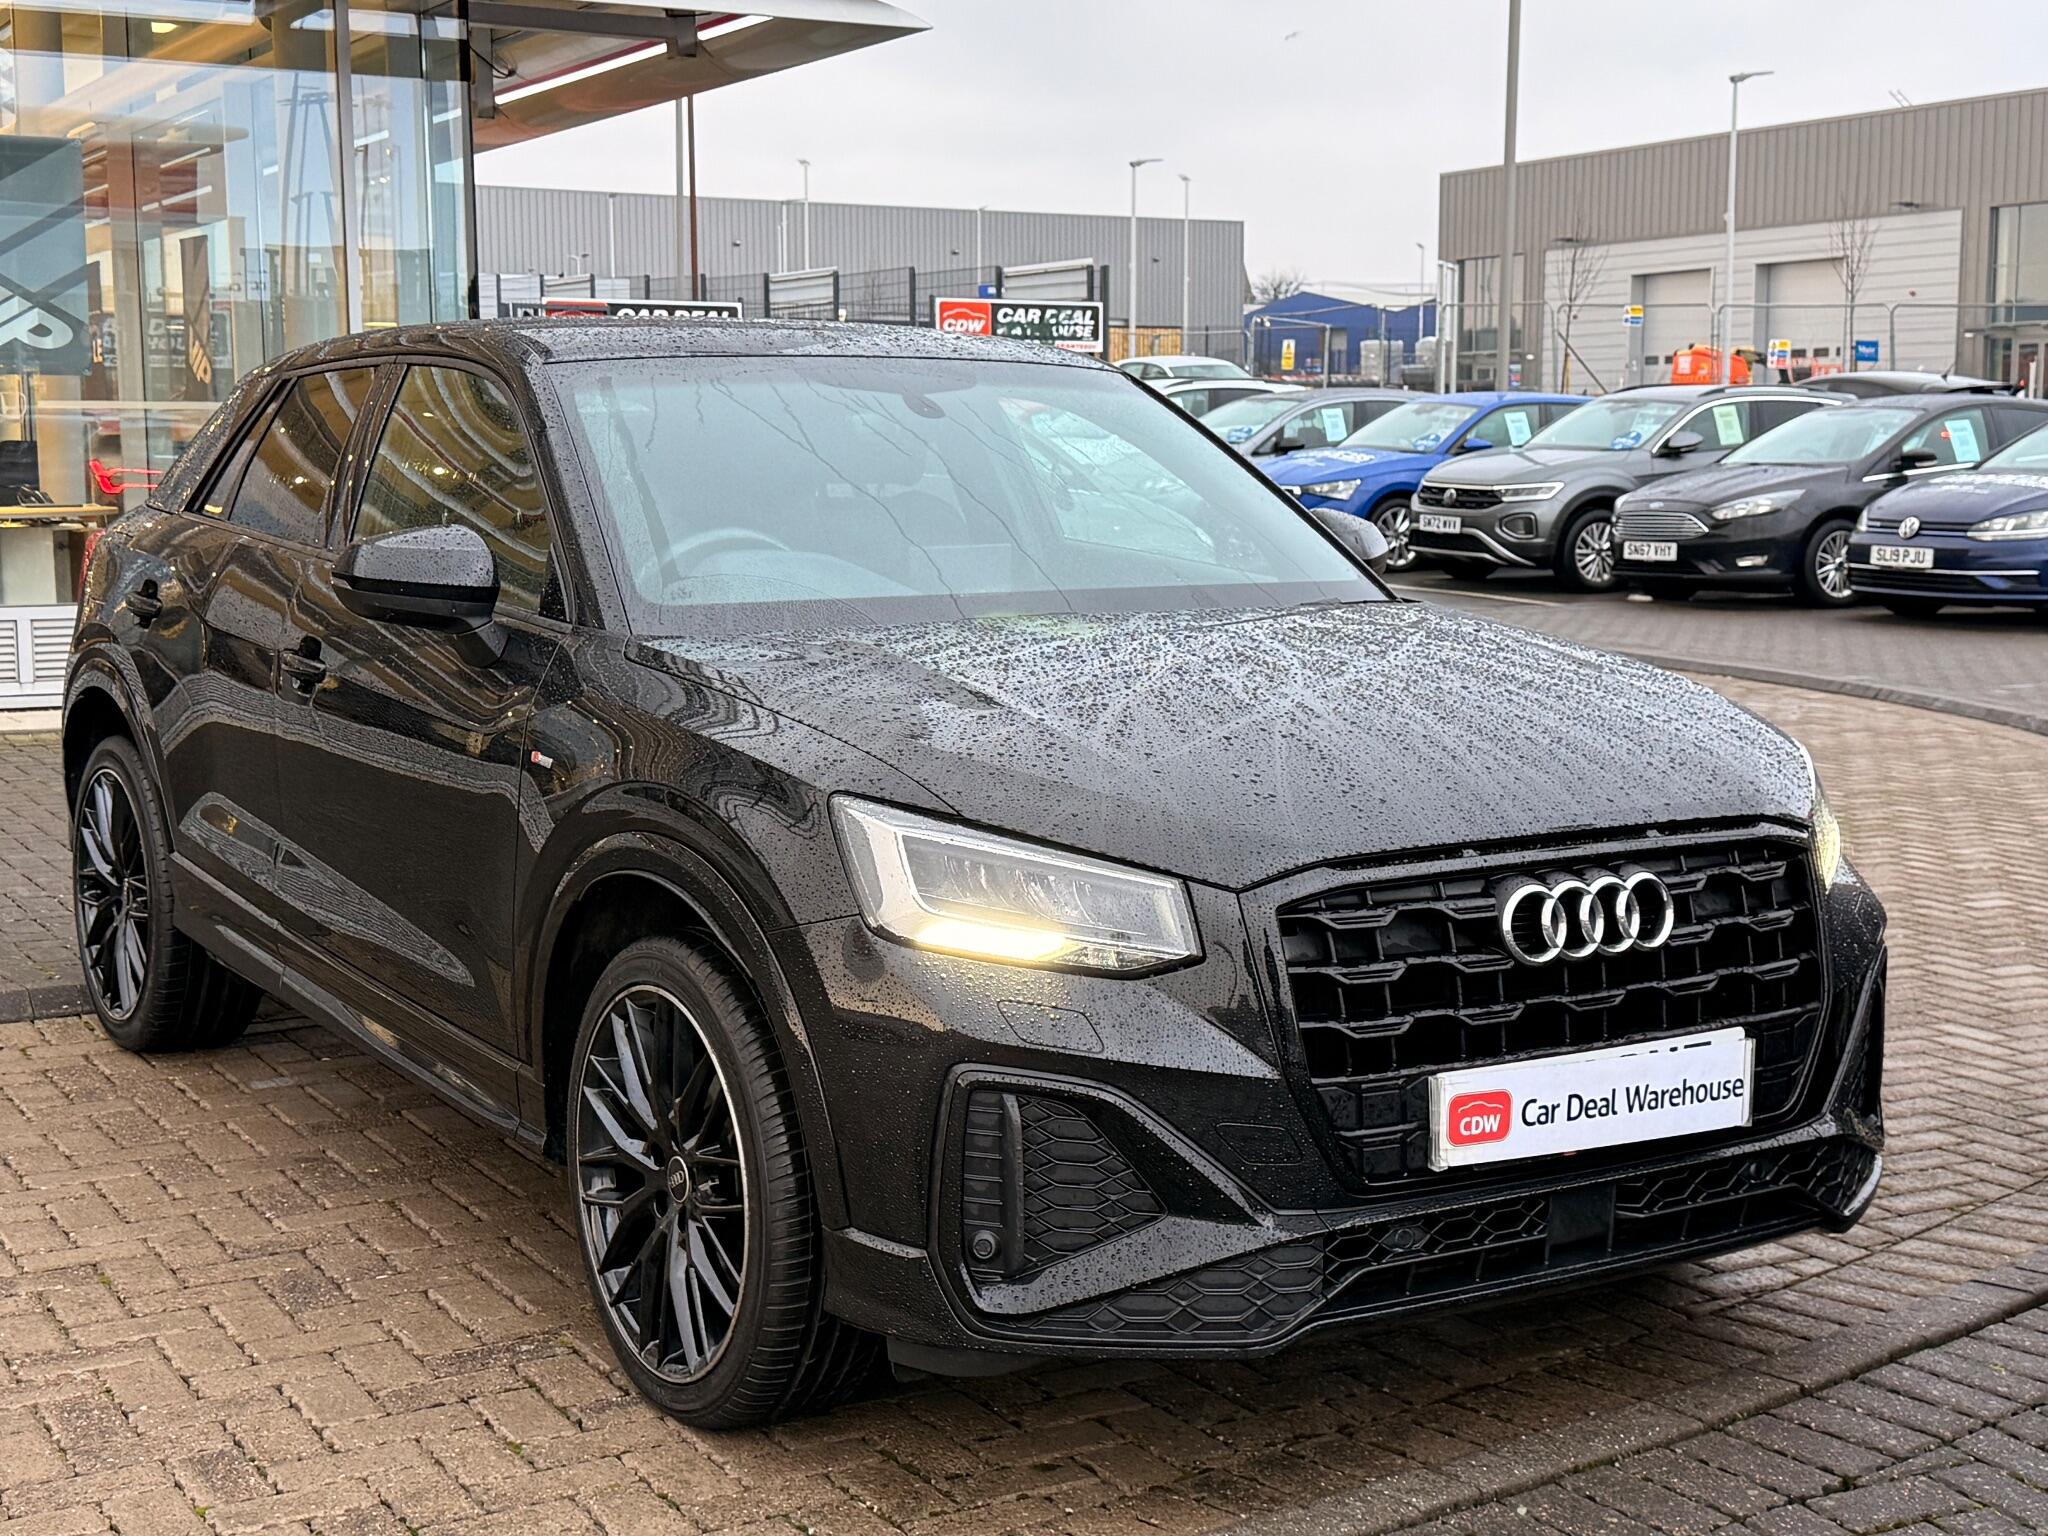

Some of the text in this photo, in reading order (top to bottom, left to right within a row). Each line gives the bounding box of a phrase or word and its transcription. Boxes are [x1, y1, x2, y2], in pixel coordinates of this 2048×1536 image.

[996, 307, 1042, 324] CAR
[942, 319, 986, 333] CDW
[1876, 547, 1926, 564] SL19 PJU
[1521, 1077, 1744, 1127] Car Deal Warehouse
[1459, 1113, 1502, 1136] CDW
